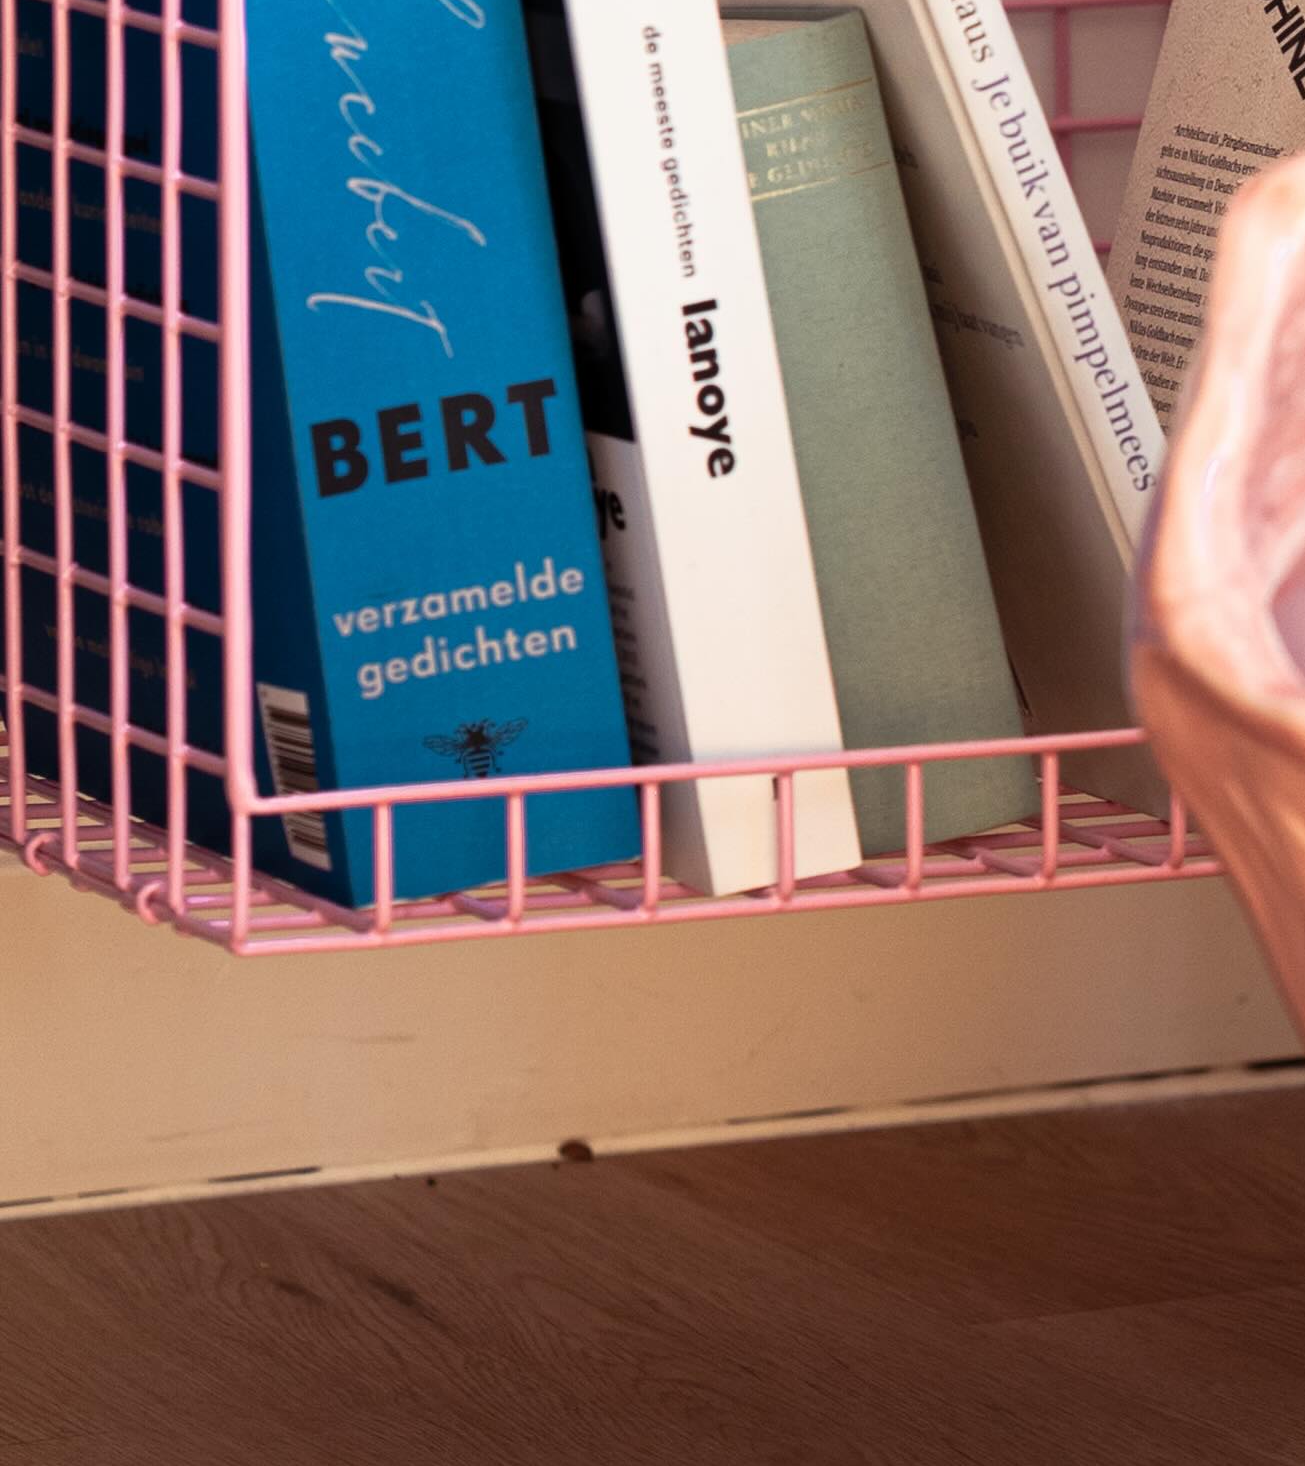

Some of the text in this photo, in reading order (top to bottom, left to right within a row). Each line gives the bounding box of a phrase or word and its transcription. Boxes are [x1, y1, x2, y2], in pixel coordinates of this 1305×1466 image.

[972, 74, 1012, 111] Je
[643, 24, 697, 278] de meeste gedichten
[999, 110, 1051, 199] buik
[1034, 201, 1071, 268] van
[681, 298, 736, 479] lanoye
[1047, 271, 1157, 493] pimpelmees
[310, 378, 557, 498] BERT
[333, 557, 586, 637] verzamelde
[357, 624, 578, 700] gedichten
